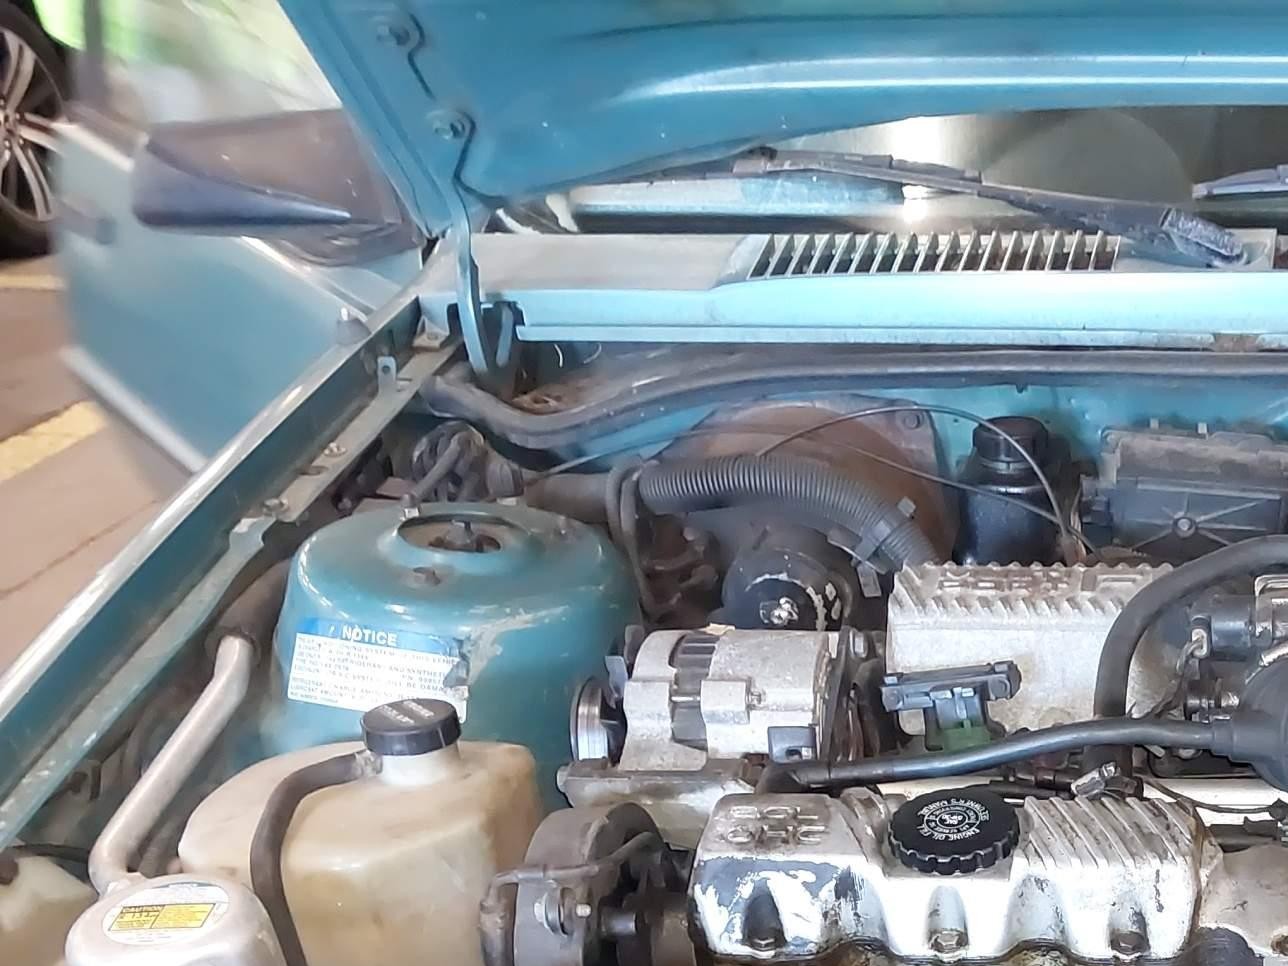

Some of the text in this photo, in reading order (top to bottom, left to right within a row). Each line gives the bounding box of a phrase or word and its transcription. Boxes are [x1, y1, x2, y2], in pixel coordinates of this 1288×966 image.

[342, 624, 397, 646] NOTICE
[727, 825, 825, 845] OHC
[933, 831, 946, 842] OIL
[948, 827, 981, 842] ENGINE
